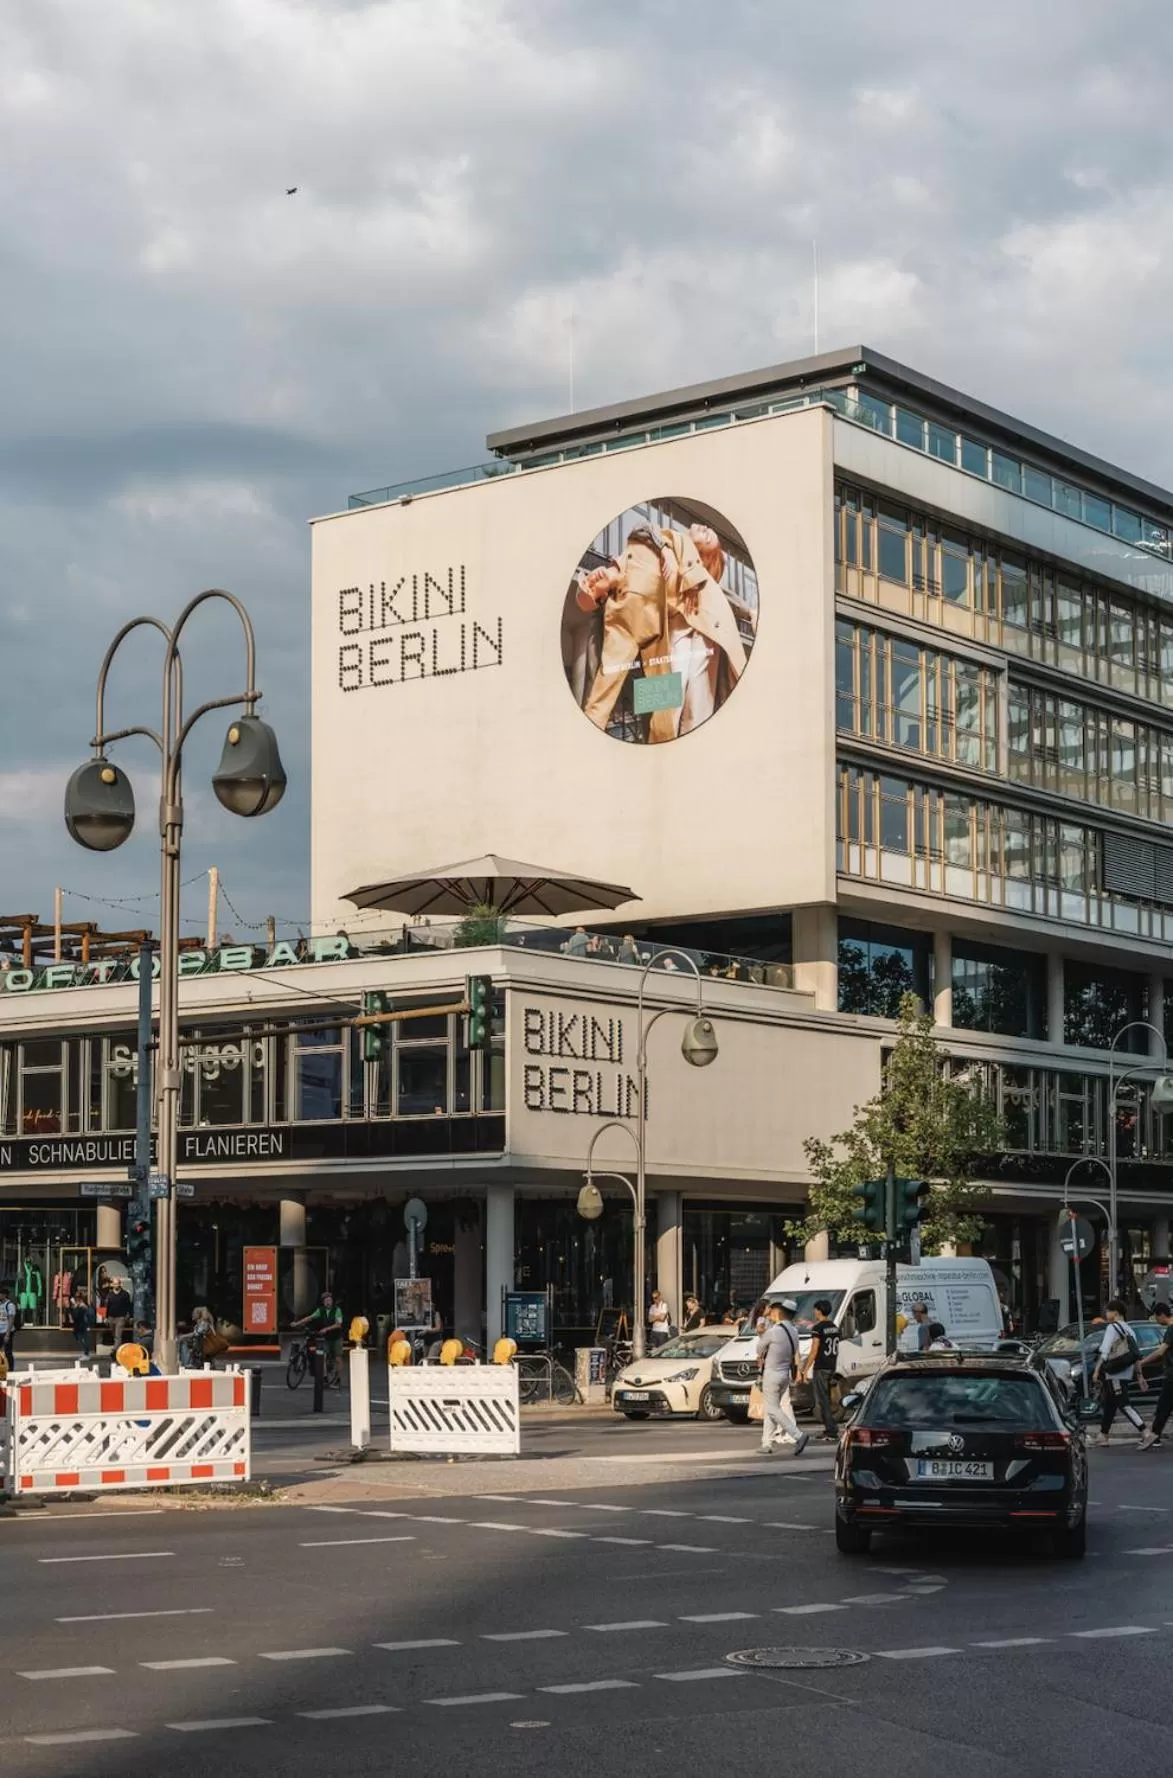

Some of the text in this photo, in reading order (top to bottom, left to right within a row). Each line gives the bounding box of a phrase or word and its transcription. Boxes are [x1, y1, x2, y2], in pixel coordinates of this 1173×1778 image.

[339, 565, 465, 636] BIKINI
[339, 616, 502, 692] BERLIN
[524, 1008, 622, 1064] BIKINI
[524, 1065, 648, 1121] BERLIN
[29, 1139, 160, 1165] SCHNABULIEE
[186, 1134, 283, 1157] FLANIEREN
[902, 1292, 935, 1302] GLOBAL
[965, 1463, 988, 1477] 421
